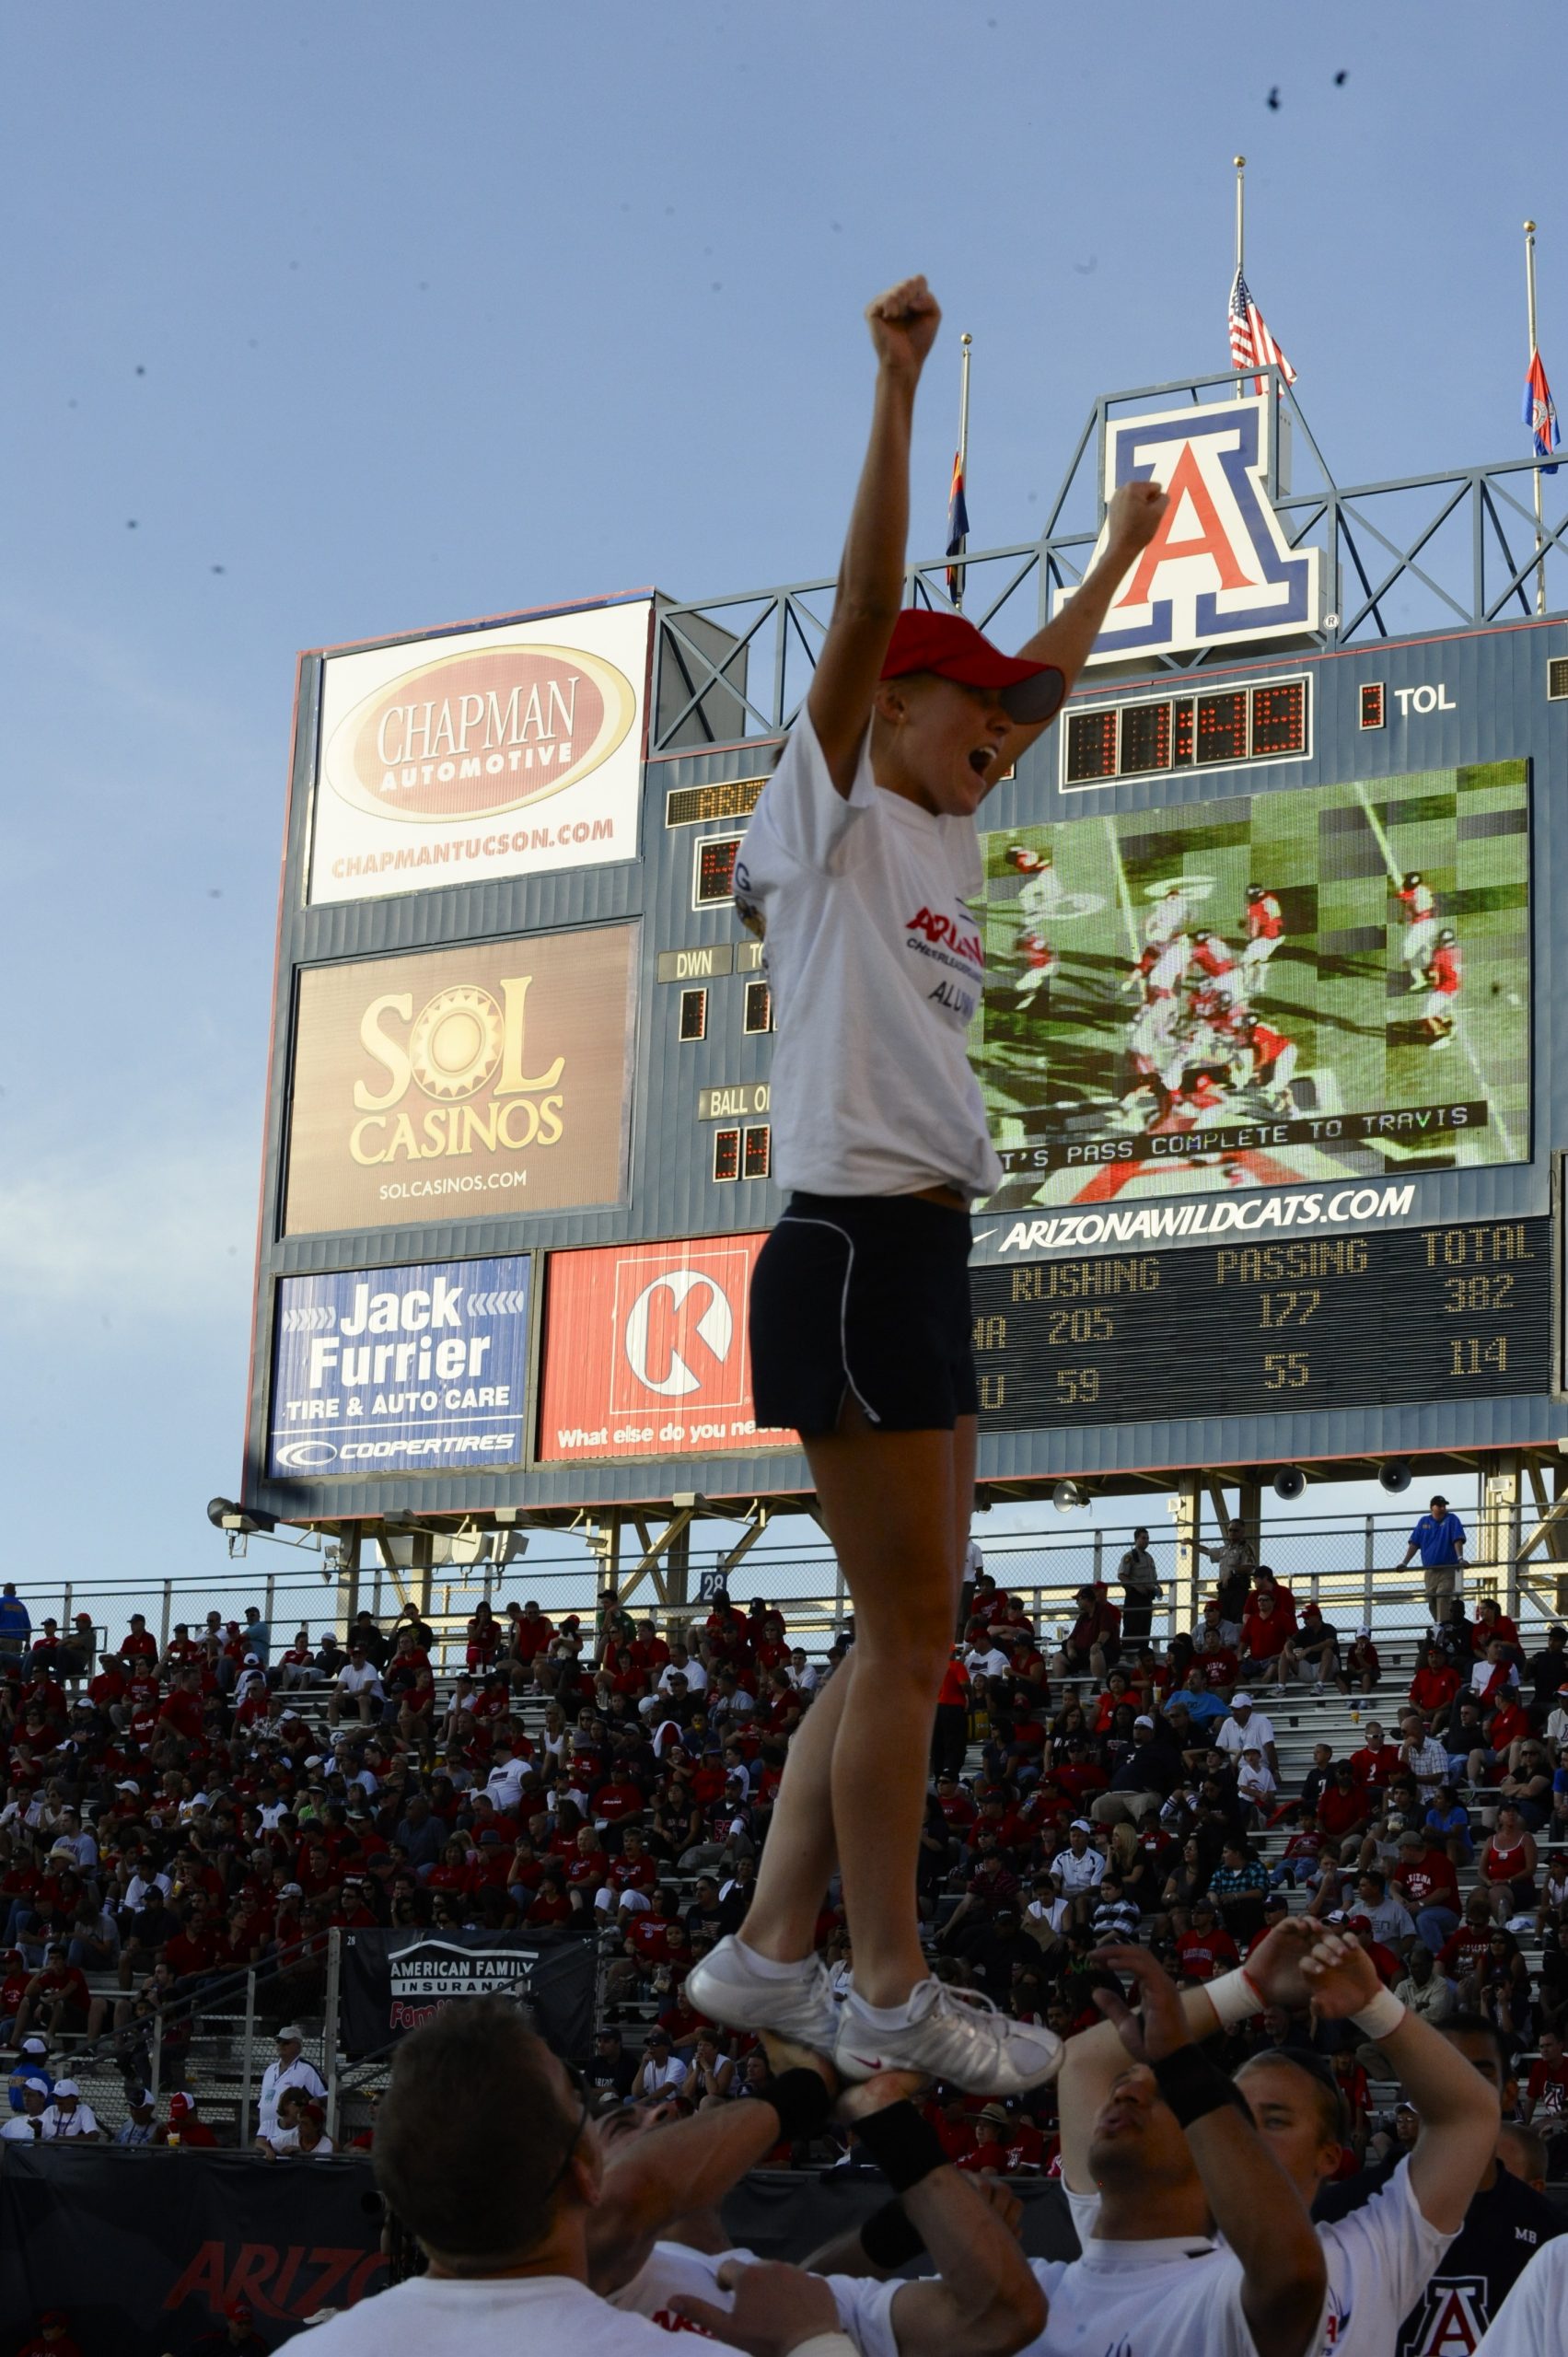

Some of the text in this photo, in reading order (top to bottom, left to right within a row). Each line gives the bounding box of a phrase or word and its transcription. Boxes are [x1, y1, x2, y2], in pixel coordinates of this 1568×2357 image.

[380, 677, 579, 766] CHAPMAN
[1394, 683, 1457, 716] TOL
[379, 742, 572, 792] AUTOMOTIVE
[332, 819, 613, 878] CHAPMANTUCSON.COM
[677, 950, 713, 978] DWN
[354, 976, 565, 1110] SOL
[710, 1086, 770, 1118] BALL O
[349, 1095, 564, 1166] CASINOS
[1067, 1142, 1133, 1165] PASS
[1151, 1122, 1289, 1157] COMPLETE
[1310, 1119, 1342, 1139] TO
[1362, 1107, 1469, 1134] TRAVIS
[379, 1169, 528, 1200] SOLCASINOS.COM
[998, 1184, 1416, 1252] ARIZONAWILDCATS.COM
[1012, 1225, 1535, 1302] RUSHING PASSING TOTAL
[340, 1276, 464, 1337] Jack
[1049, 1306, 1113, 1344] 205
[1260, 1290, 1320, 1328] 177
[1445, 1273, 1514, 1312] 382
[309, 1335, 491, 1388] Furrier
[1057, 1369, 1099, 1404] 59
[1265, 1353, 1308, 1388] 55
[1450, 1337, 1506, 1376] 114
[286, 1386, 510, 1421] TIRE & AUTO CARE
[557, 1427, 608, 1448] What
[613, 1424, 654, 1445] else
[659, 1422, 685, 1442] do
[690, 1422, 726, 1444] you
[346, 1935, 356, 1946] 28
[390, 1961, 534, 1978] AMERICAN FAMILY
[389, 1999, 452, 2029] Fam
[1514, 2226, 1537, 2245] MB
